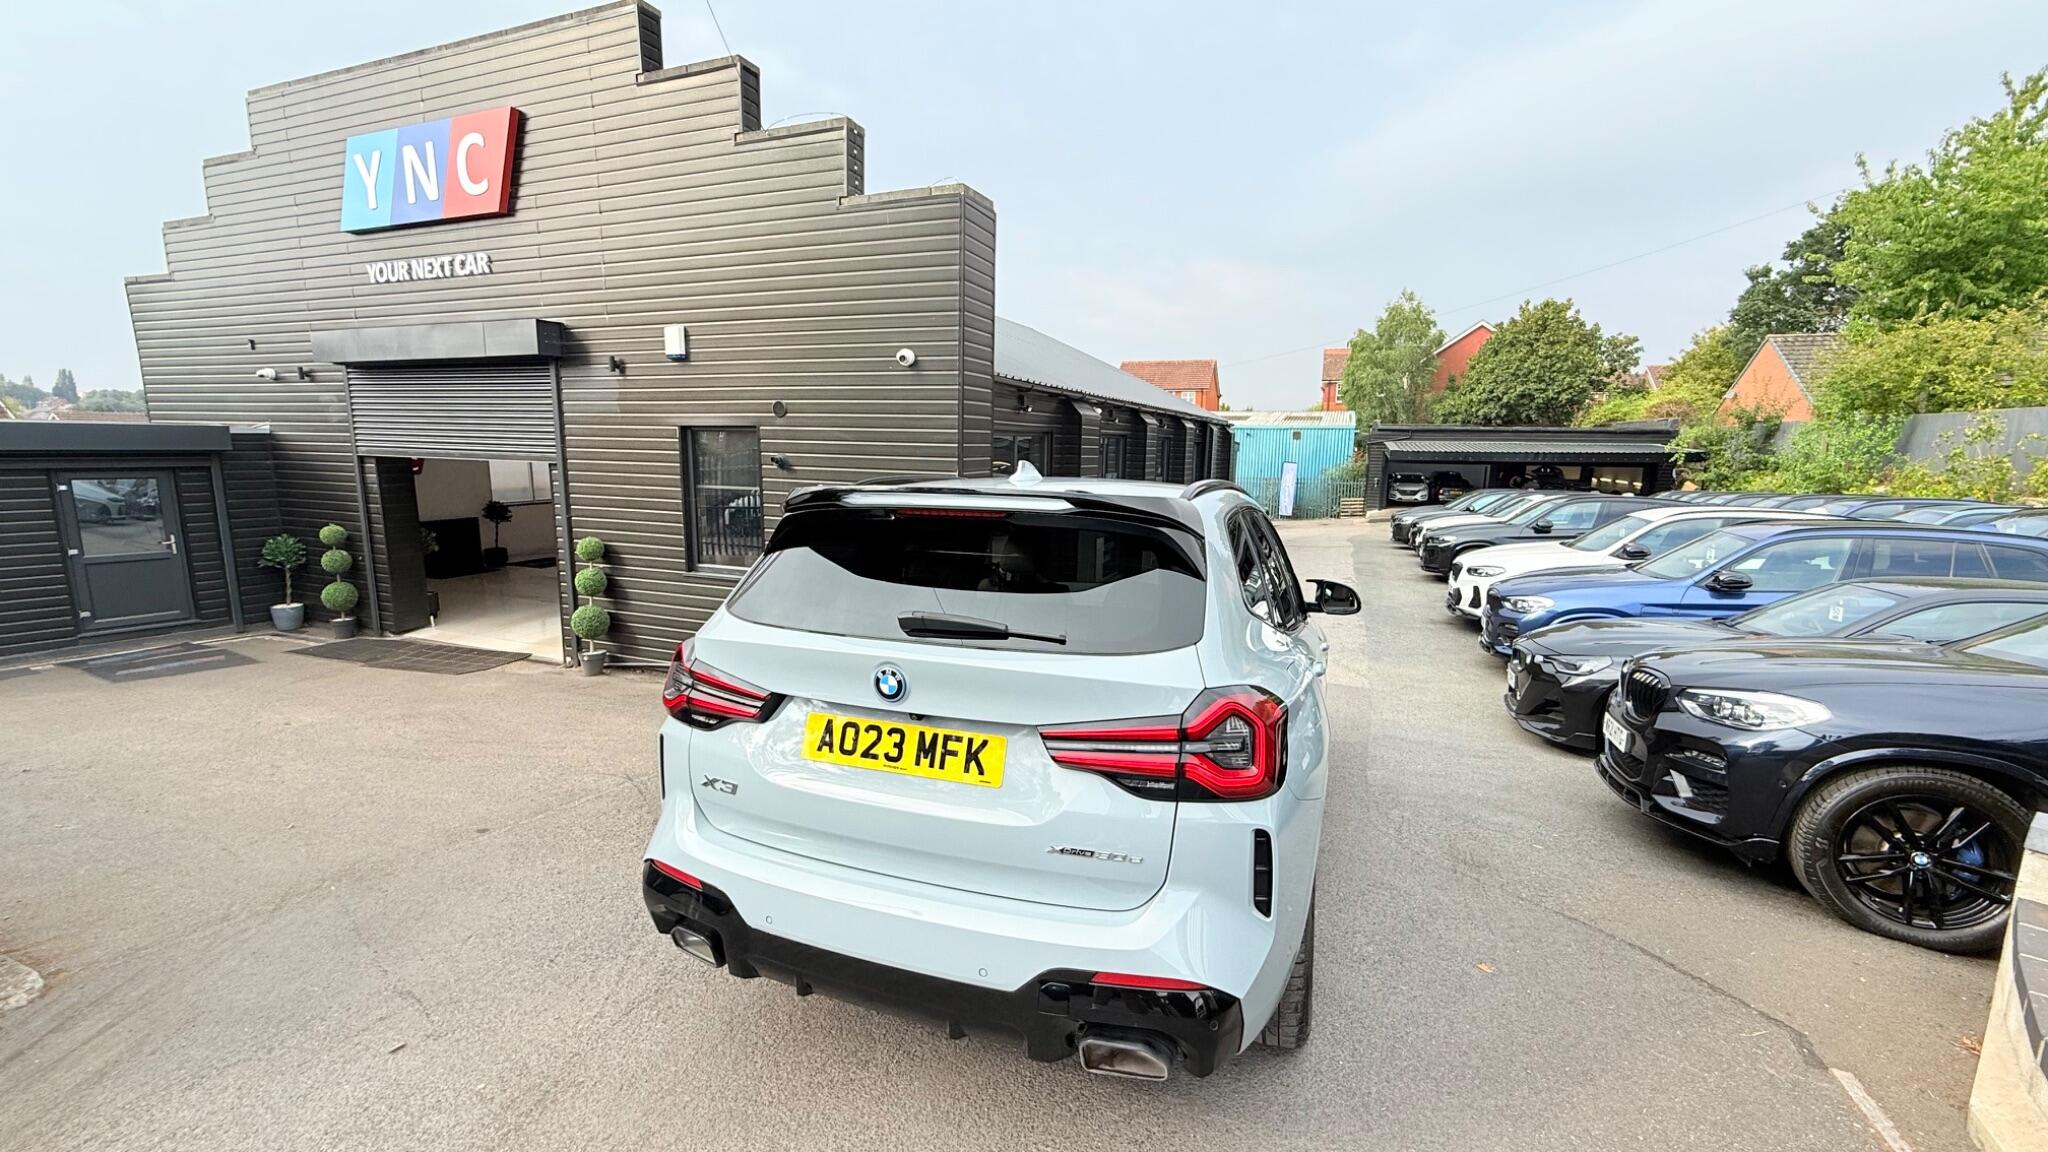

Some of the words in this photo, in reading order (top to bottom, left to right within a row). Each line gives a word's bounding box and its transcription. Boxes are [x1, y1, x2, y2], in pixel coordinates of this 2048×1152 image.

[352, 131, 489, 210] YNC
[366, 261, 410, 283] YOUR
[411, 257, 453, 280] NEXT
[453, 252, 491, 276] CAR
[816, 718, 906, 763] AO23
[914, 730, 989, 776] MFK
[701, 774, 739, 795] X3
